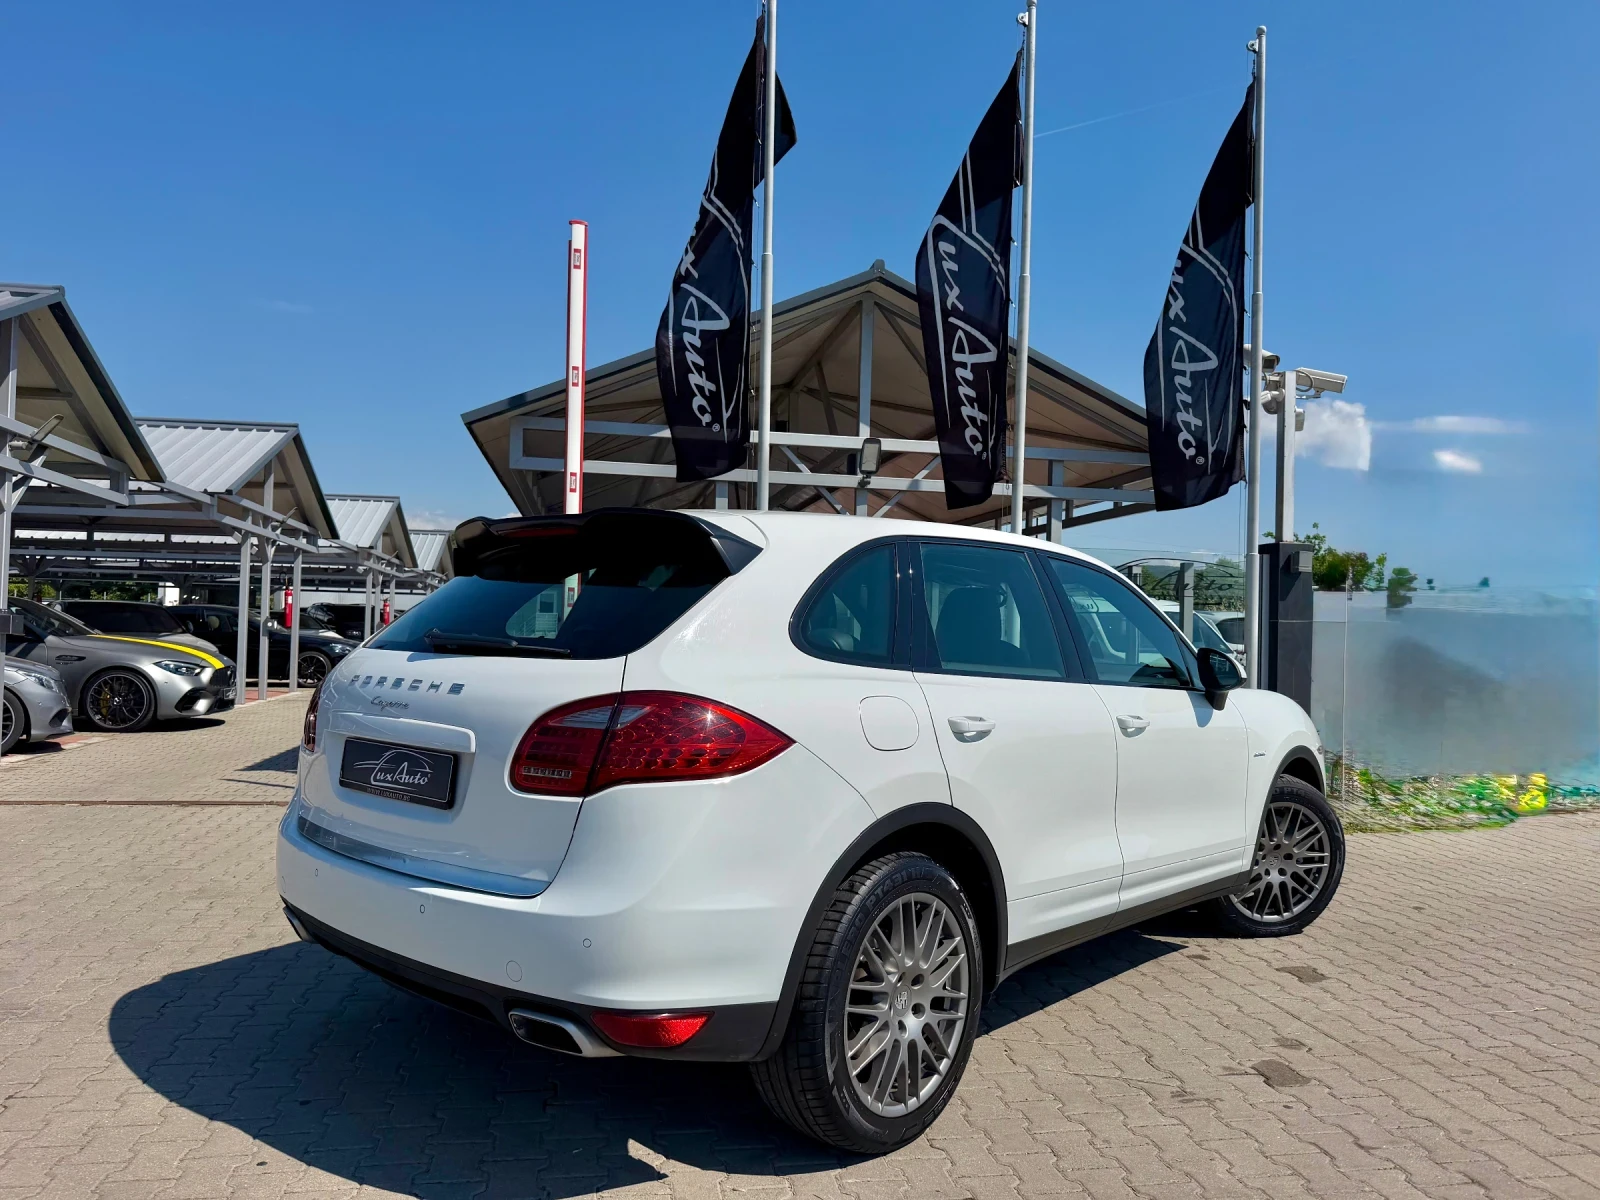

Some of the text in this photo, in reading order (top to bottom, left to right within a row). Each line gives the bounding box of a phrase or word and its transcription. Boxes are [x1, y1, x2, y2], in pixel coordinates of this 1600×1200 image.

[350, 675, 465, 696] PORSCHE
[371, 696, 410, 711] Cayenne
[865, 869, 908, 911] PT431
